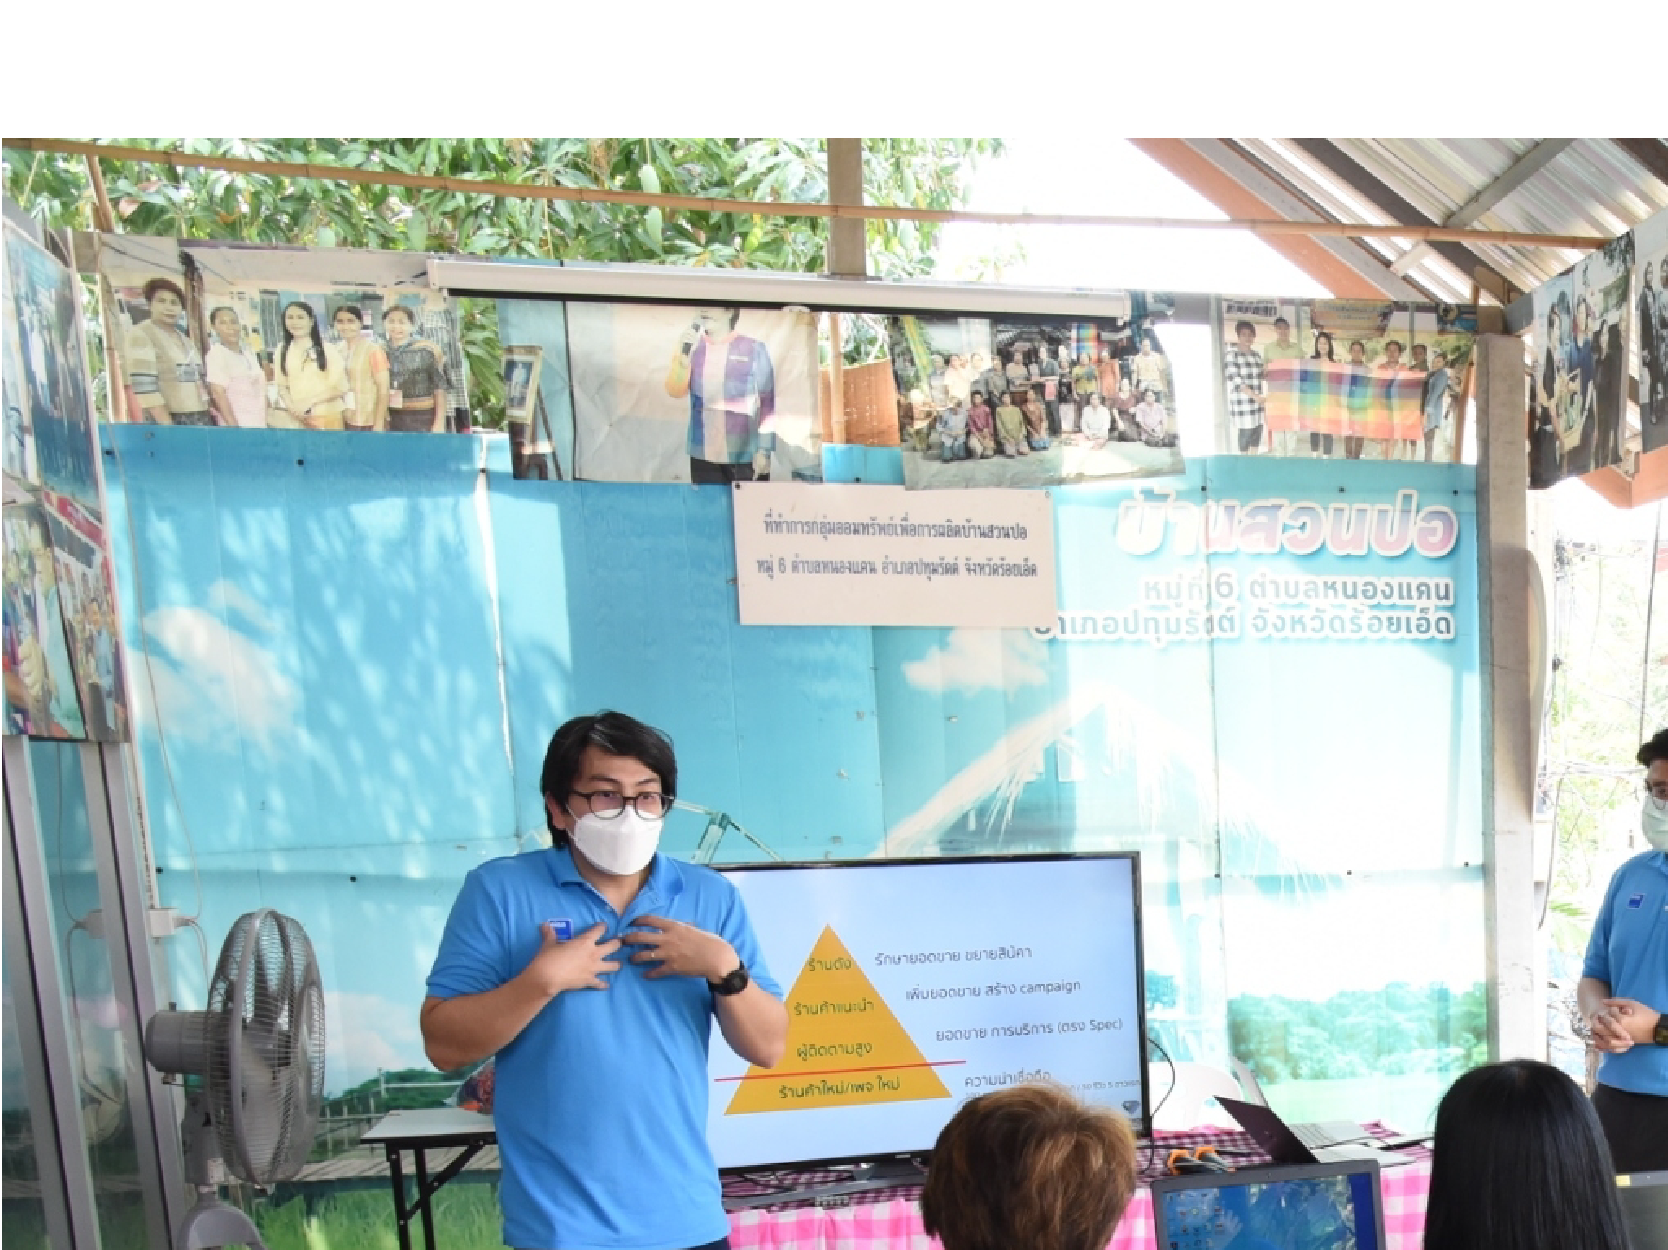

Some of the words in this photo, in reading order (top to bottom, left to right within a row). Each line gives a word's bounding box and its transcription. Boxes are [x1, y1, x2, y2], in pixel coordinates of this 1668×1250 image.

[1115, 487, 1458, 556] บ้านสวนปอ
[756, 554, 774, 581] หมู่
[778, 557, 787, 574] 6
[1214, 573, 1235, 599] 6
[1249, 573, 1452, 600] ตำบลหนองแคน
[1252, 605, 1452, 636] จังหวัดร้อยเอ็ด
[1019, 980, 1081, 995] campaign
[1089, 1018, 1123, 1032] Spec)
